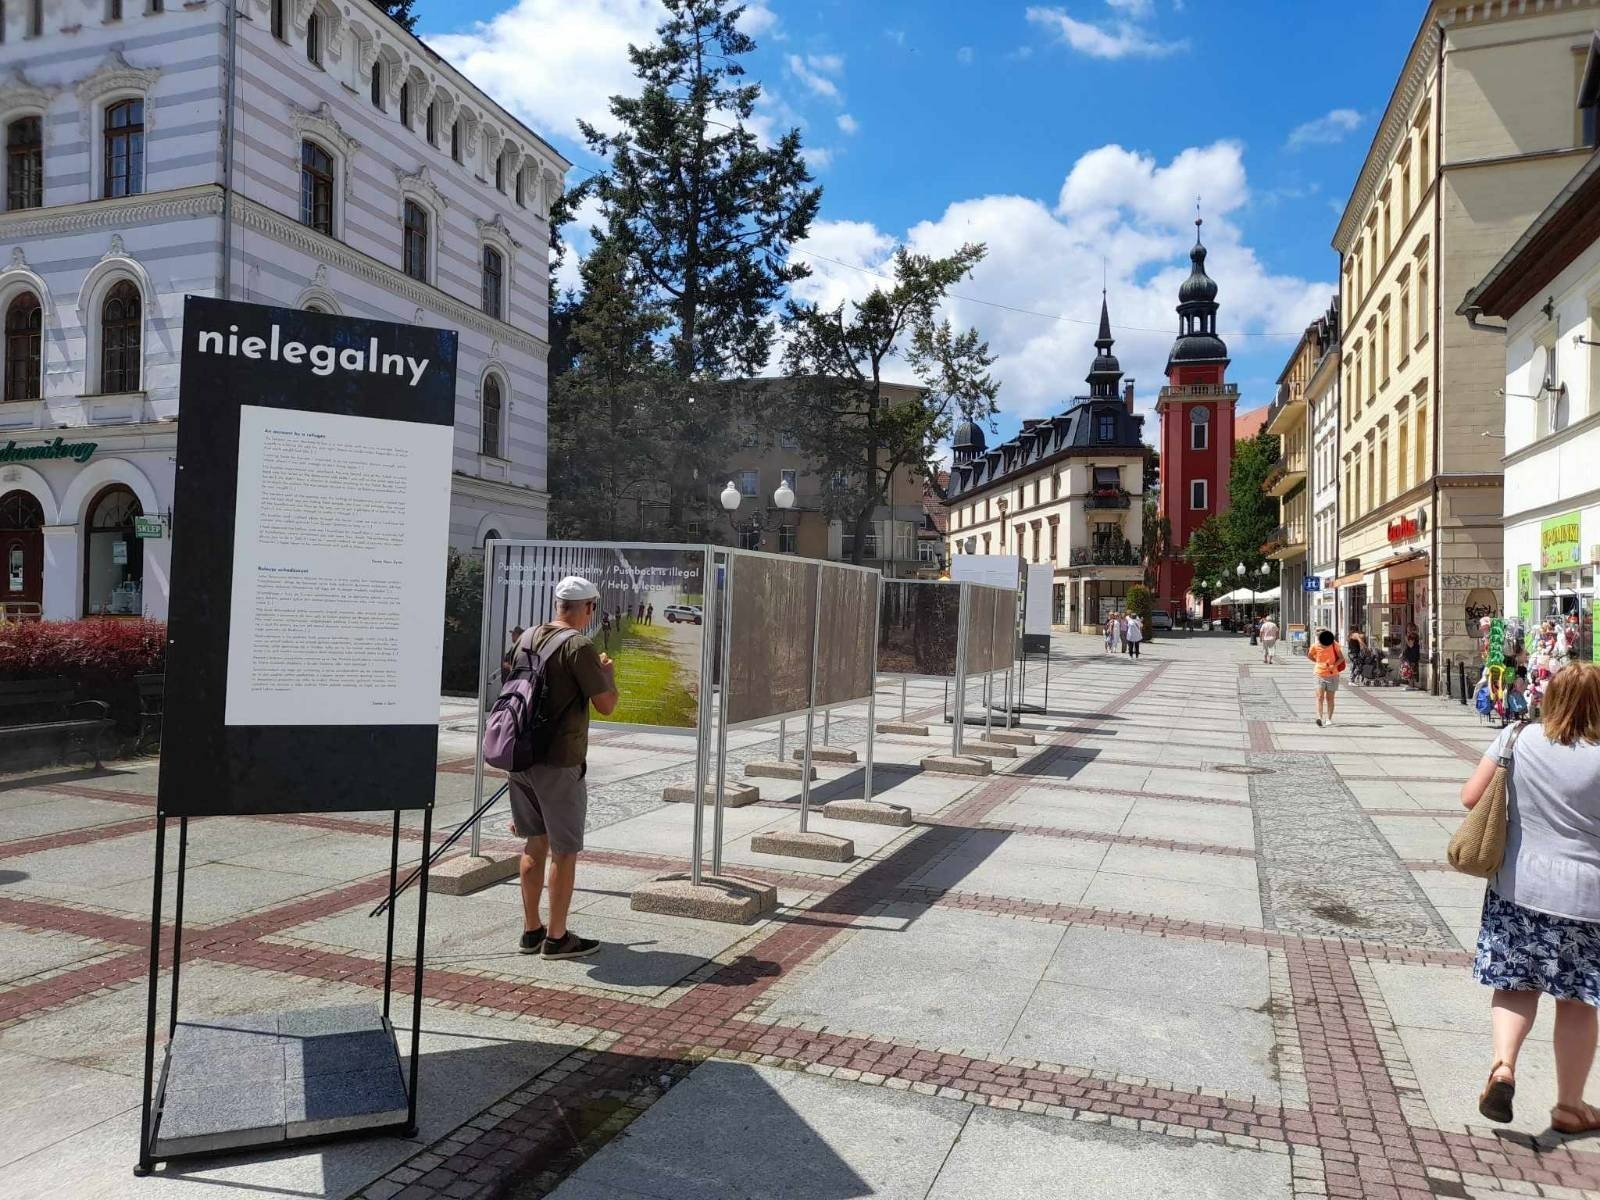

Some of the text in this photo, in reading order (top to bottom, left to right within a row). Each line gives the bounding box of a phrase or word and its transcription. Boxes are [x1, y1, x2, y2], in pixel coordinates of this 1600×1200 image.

[198, 324, 430, 386] nielegalny
[137, 525, 161, 533] SKLEP
[498, 562, 537, 573] Pushback
[559, 565, 603, 577] nielegalny
[613, 565, 657, 576] Pushback
[659, 566, 667, 576] is
[669, 566, 699, 579] illegal
[608, 580, 629, 591] Help
[642, 581, 665, 592] legal
